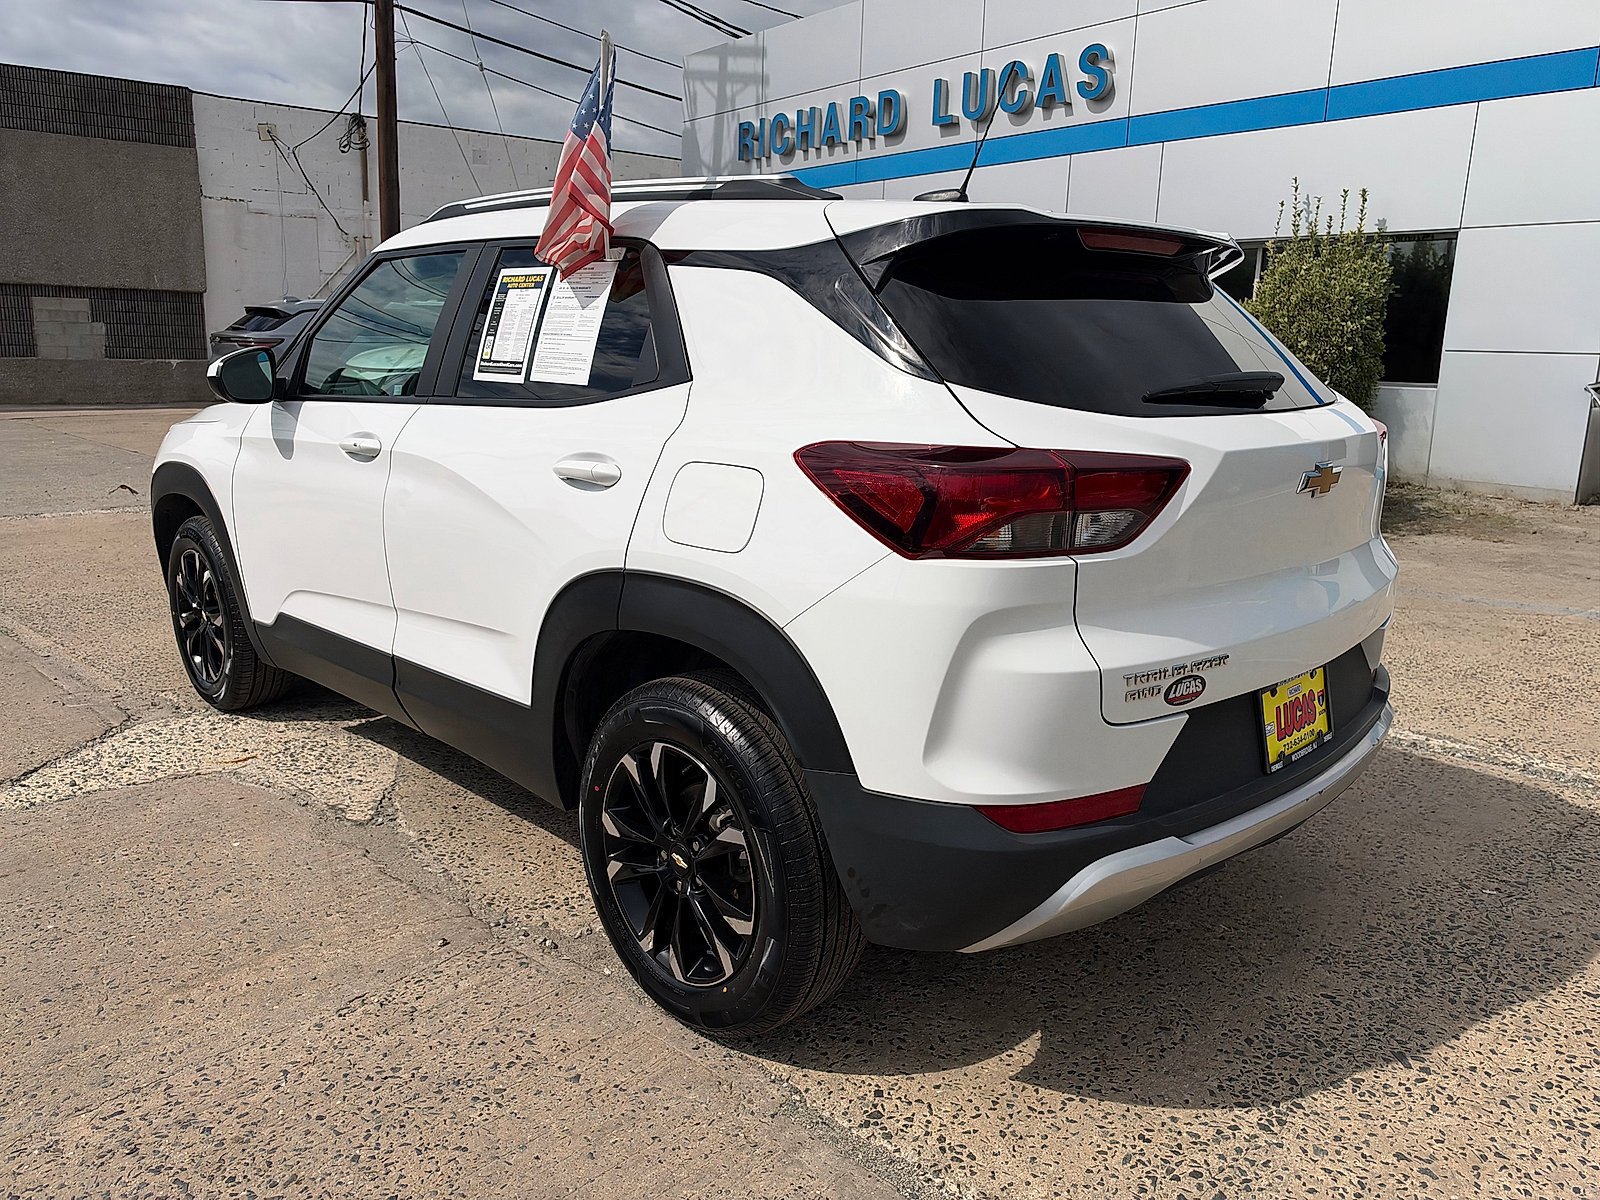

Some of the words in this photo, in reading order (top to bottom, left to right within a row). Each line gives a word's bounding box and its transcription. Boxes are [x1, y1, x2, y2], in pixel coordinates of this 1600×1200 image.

[738, 88, 906, 162] RICHARD
[932, 43, 1113, 127] LUCAS
[502, 275, 525, 283] RICHARD
[525, 274, 544, 283] LUCAS
[1123, 653, 1230, 687] TRAILBLAZER
[1168, 677, 1203, 699] LUCAS
[1275, 689, 1317, 742] LUCAS
